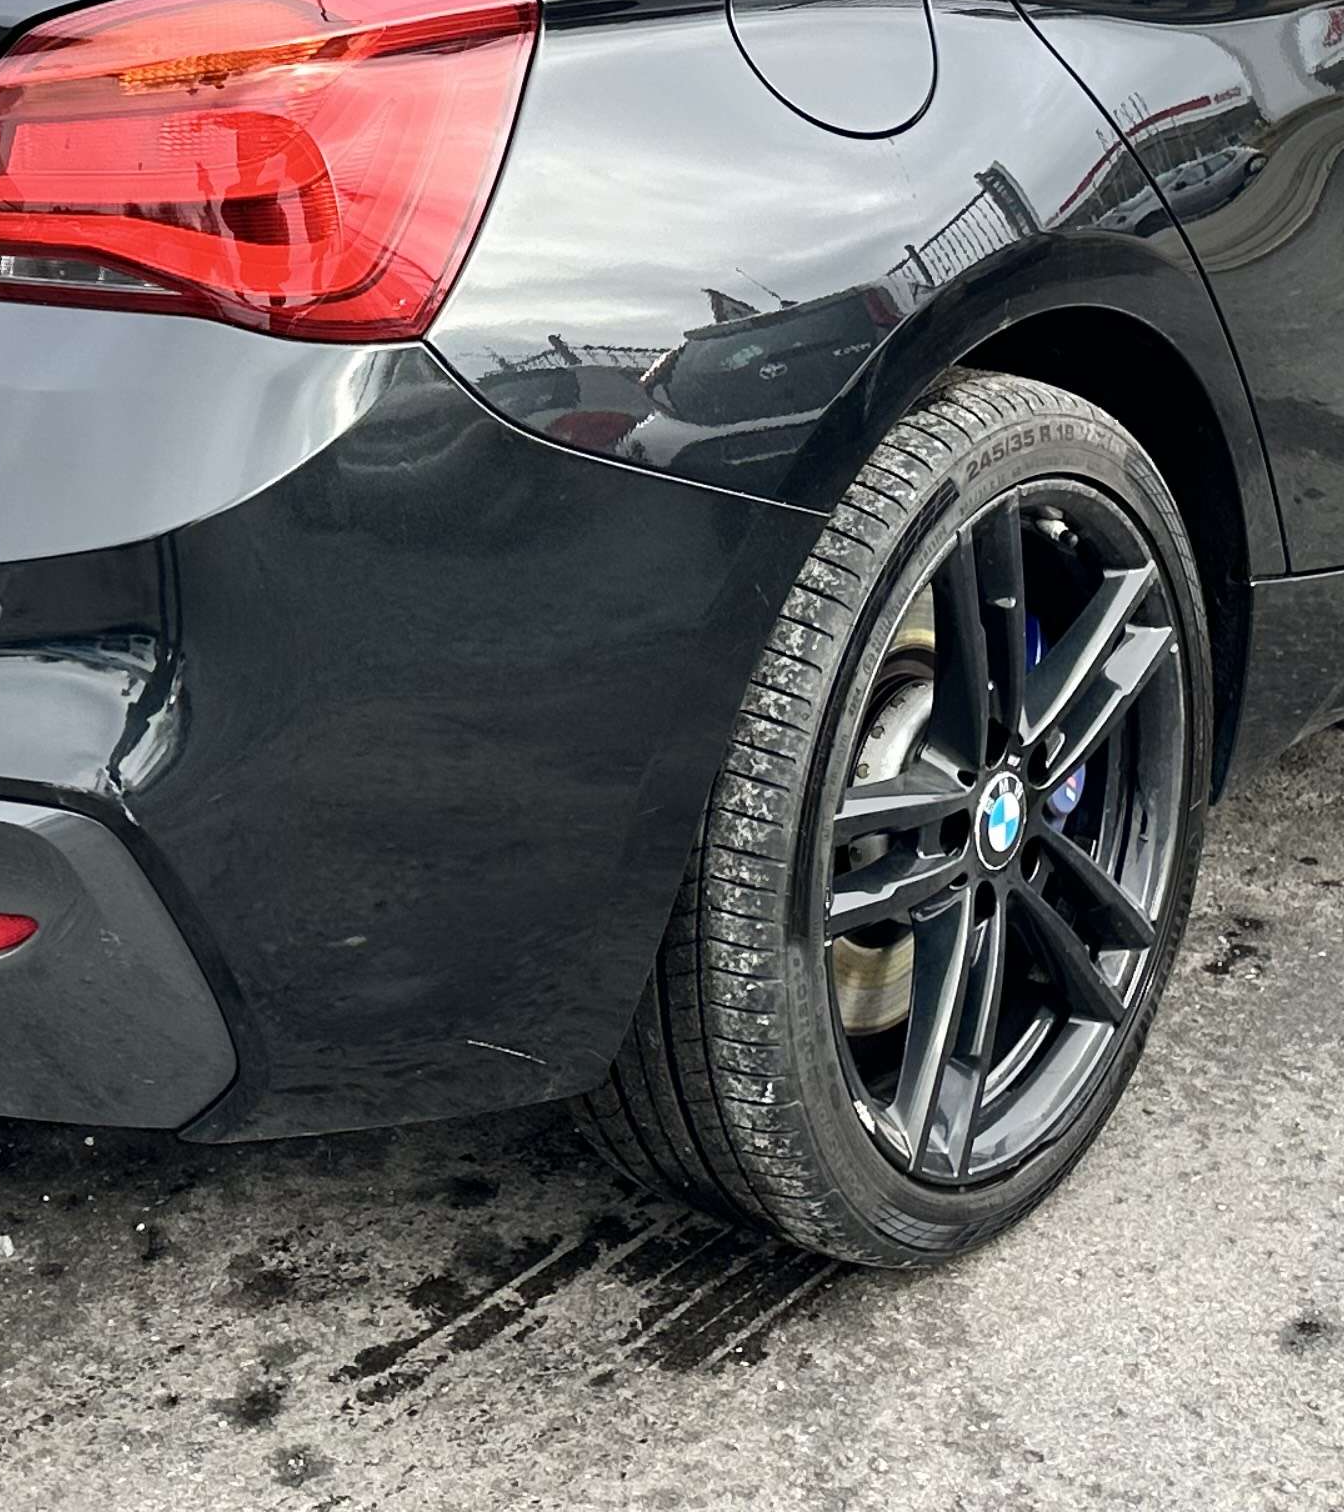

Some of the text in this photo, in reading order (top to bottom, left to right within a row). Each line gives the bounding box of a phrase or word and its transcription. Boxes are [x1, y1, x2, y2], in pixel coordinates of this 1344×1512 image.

[966, 424, 1075, 483] 245/35 R 18
